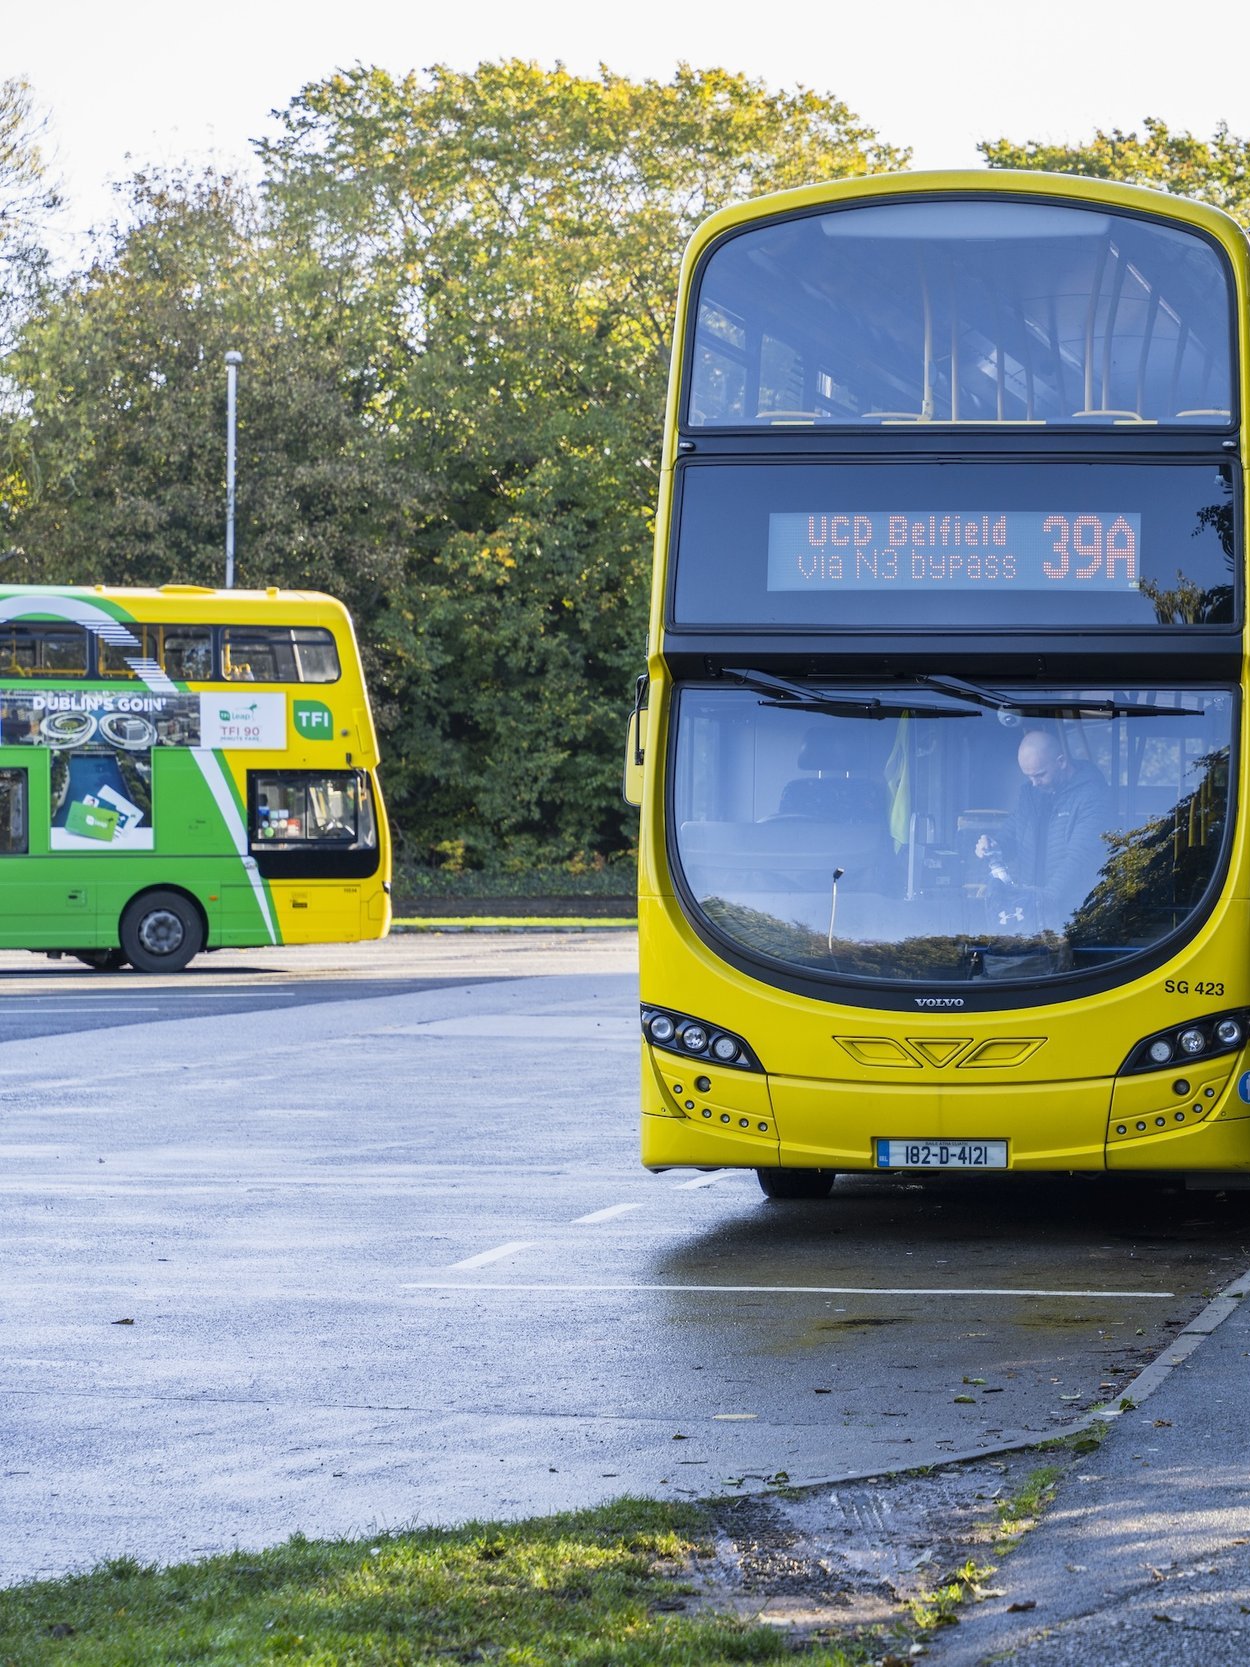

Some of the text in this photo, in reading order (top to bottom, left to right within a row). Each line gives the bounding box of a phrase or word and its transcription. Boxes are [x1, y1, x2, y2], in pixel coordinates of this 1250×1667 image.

[808, 516, 1006, 546] UCD Belfield
[1043, 515, 1135, 579] 39A
[799, 549, 1016, 579] via N3 bypass
[32, 696, 166, 712] DUBLIN'S GOIN'
[298, 711, 329, 727] TFI
[221, 726, 260, 737] TFI 90
[1165, 980, 1225, 996] SG 423
[914, 998, 965, 1007] VOLVO
[905, 1146, 987, 1165] 182-D-4121
